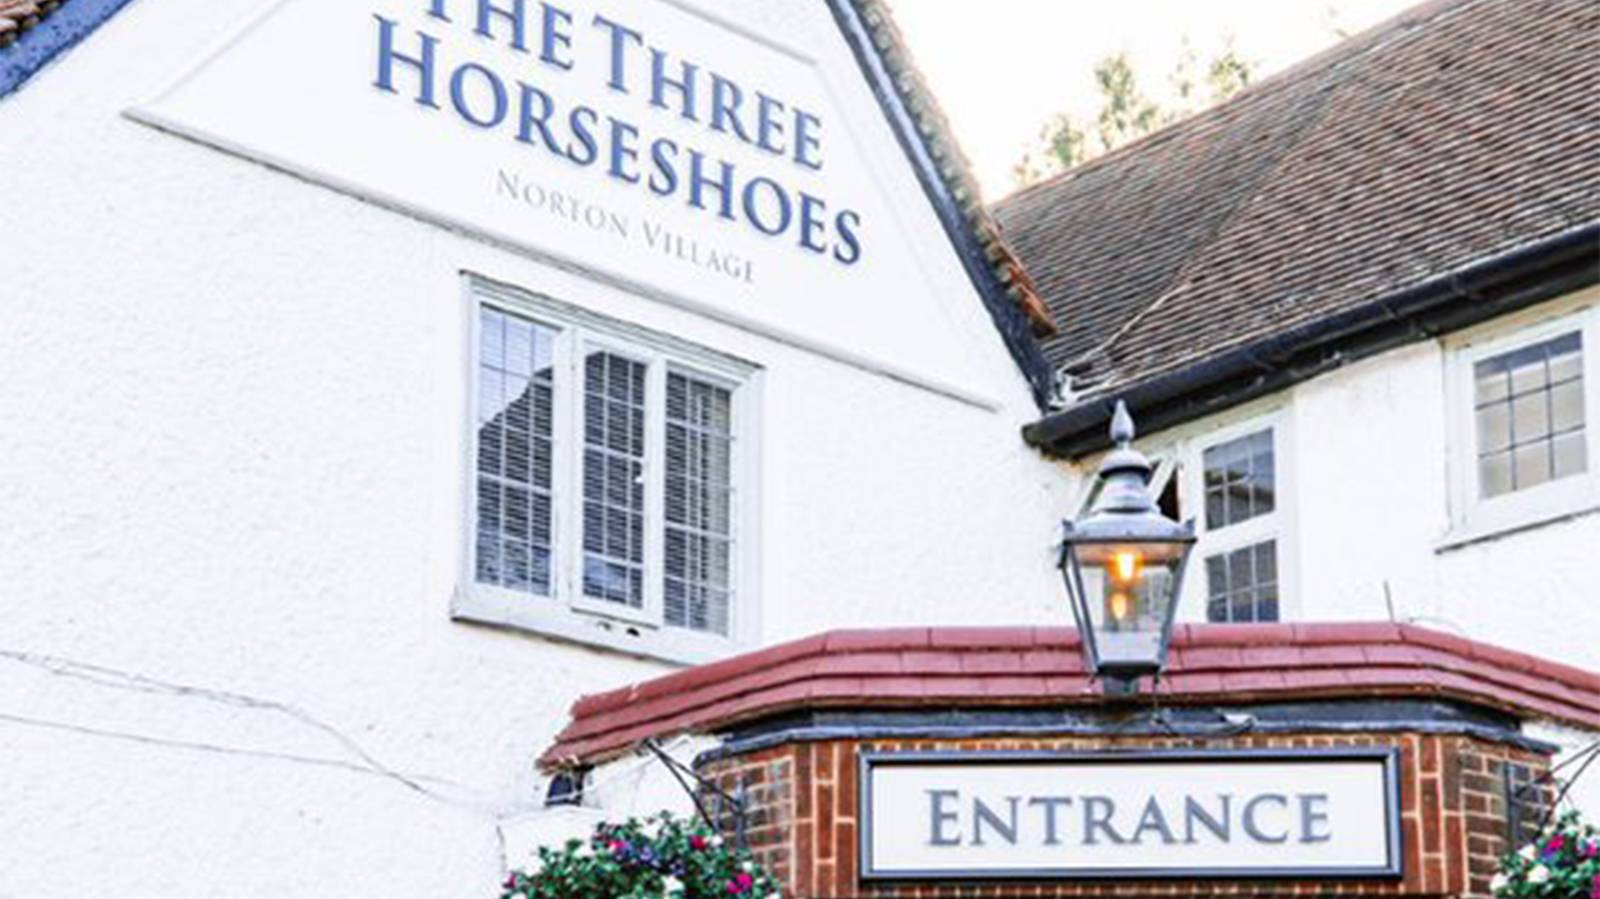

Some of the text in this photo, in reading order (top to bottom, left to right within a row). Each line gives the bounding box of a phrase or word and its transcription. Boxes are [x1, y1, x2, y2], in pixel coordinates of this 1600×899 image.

[372, 14, 863, 266] HORSESHOES
[592, 15, 824, 171] THREE
[495, 168, 755, 284] NORTON VILLAGE
[924, 788, 1332, 847] ENTRANCE
